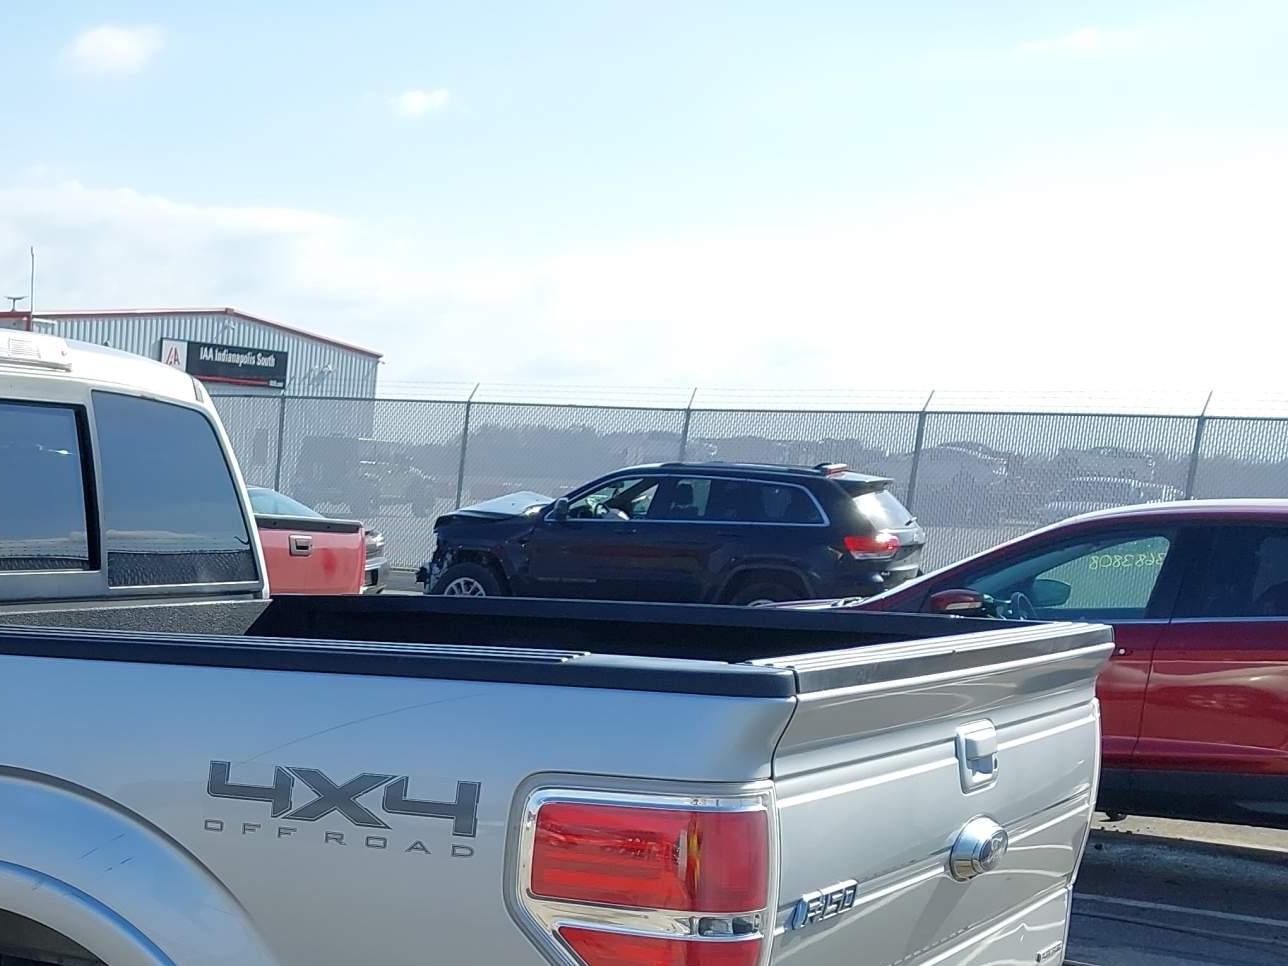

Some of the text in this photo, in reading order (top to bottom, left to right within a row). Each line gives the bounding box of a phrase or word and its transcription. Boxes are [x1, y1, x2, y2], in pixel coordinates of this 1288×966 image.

[199, 346, 214, 361] IAA
[214, 348, 256, 367] Indianapolis
[256, 352, 276, 368] South
